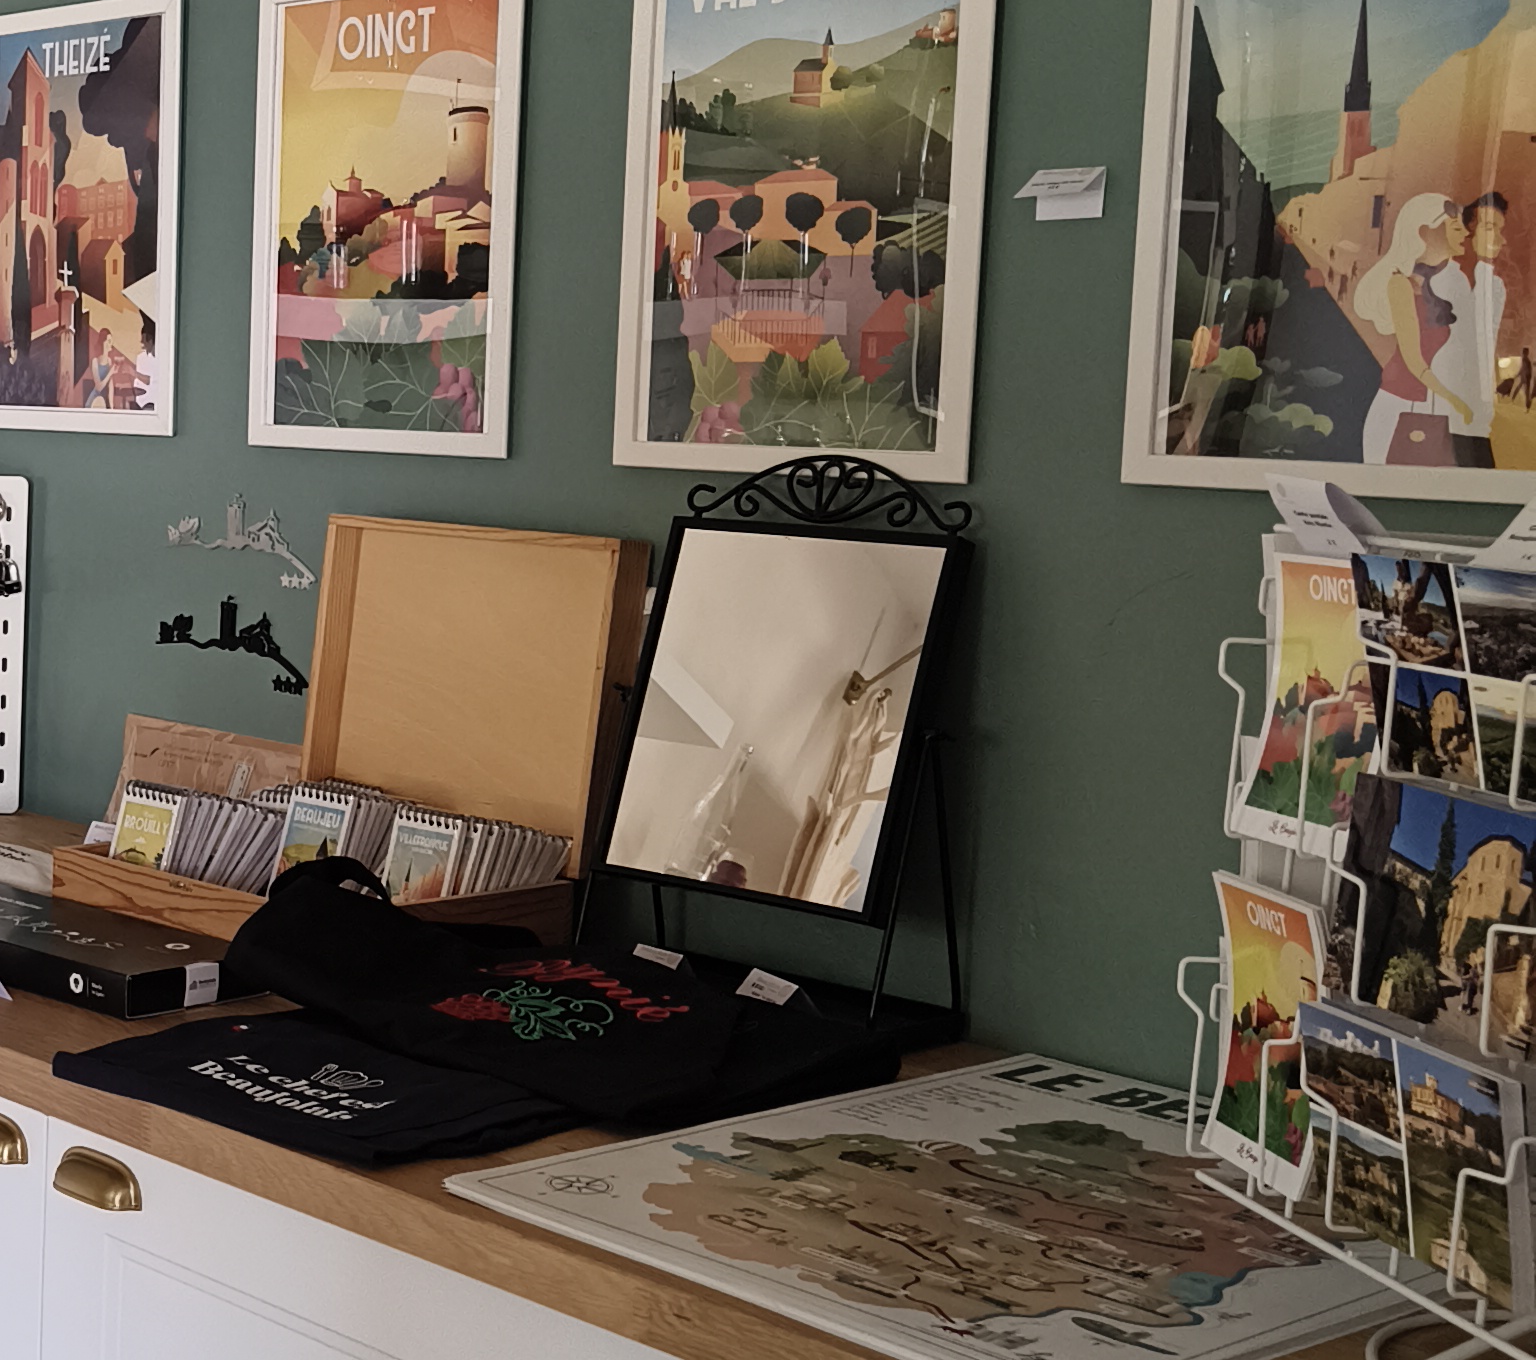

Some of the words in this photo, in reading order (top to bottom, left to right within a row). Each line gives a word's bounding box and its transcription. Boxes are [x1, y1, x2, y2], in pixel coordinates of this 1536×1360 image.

[337, 6, 436, 61] OINGT
[41, 28, 112, 78] THEIZÉ
[1309, 574, 1357, 606] OINGT
[124, 813, 170, 837] BROUILLY
[294, 805, 341, 830] BEAUJEU
[1246, 901, 1287, 938] OINGT
[188, 1059, 360, 1121] Beaujolais
[225, 1054, 270, 1075] Le
[268, 1075, 350, 1101] chef
[988, 1063, 1104, 1093] LE
